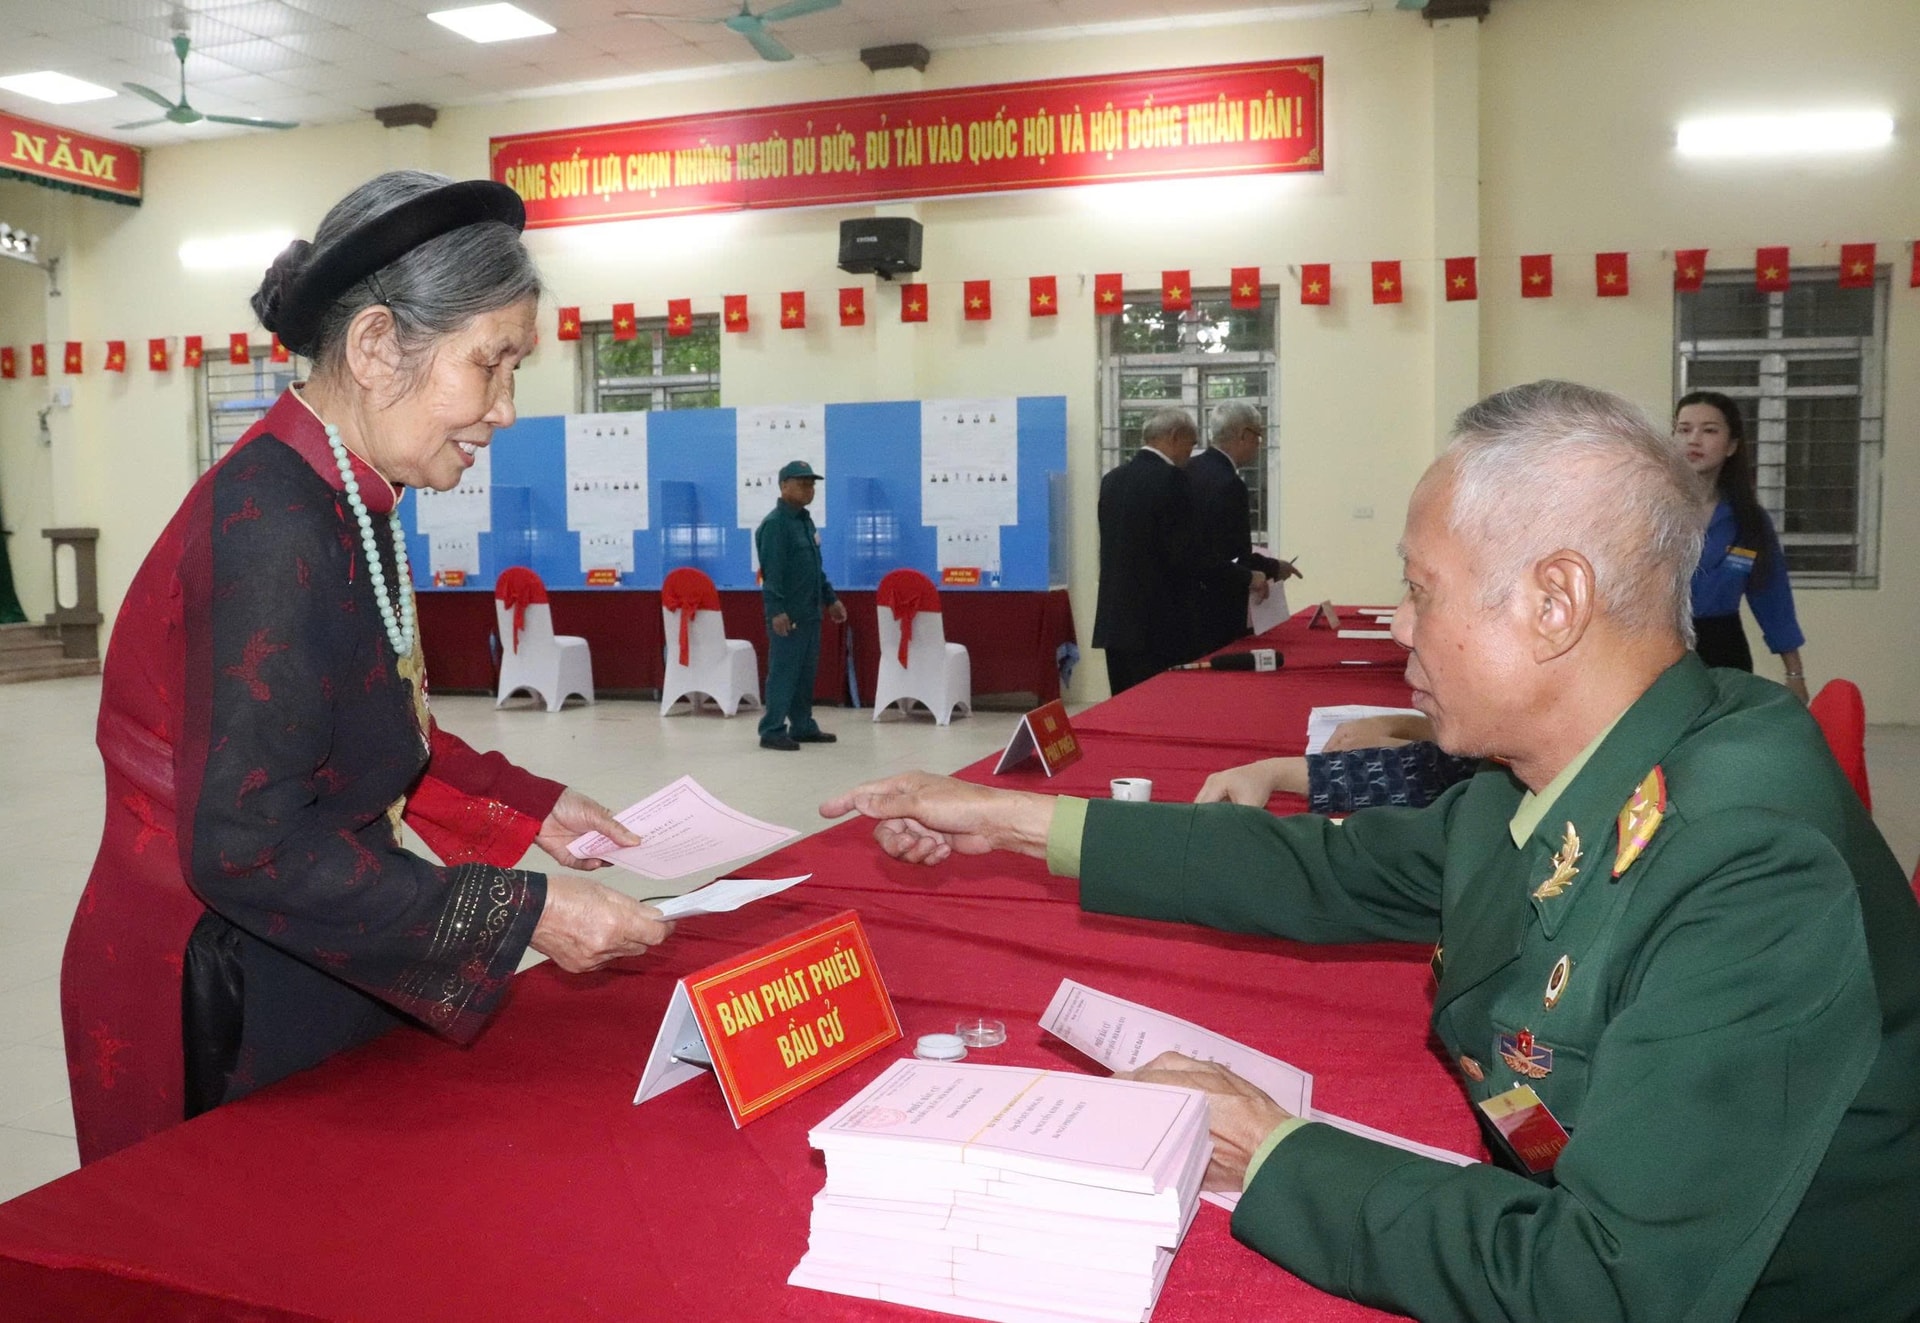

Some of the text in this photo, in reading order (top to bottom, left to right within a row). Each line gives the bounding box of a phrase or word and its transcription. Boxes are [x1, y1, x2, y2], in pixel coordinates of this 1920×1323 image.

[11, 130, 117, 182] NĂM
[505, 158, 545, 201] SÁNG
[550, 146, 589, 198] SUỐT
[593, 154, 622, 202] LỰA
[626, 152, 670, 199] CHỌN
[674, 138, 732, 186] NHỮNG
[736, 129, 787, 181] NGƯỜI
[792, 120, 815, 175] ĐỦ
[820, 122, 862, 176] ĐỨC,
[865, 114, 889, 170] ĐỦ
[894, 119, 922, 167] TÀI
[927, 116, 963, 163] VÀO
[968, 105, 1018, 162] QUỐC
[1023, 107, 1054, 164] HỘI
[1060, 104, 1086, 154] VÀ
[1090, 102, 1122, 161] HỘI
[1128, 92, 1182, 148] ĐỒNG
[1188, 92, 1244, 145] NHÂN
[716, 940, 862, 1038] BÀN PHÁT PHIẾU
[776, 998, 845, 1069] BẦU CỬ
